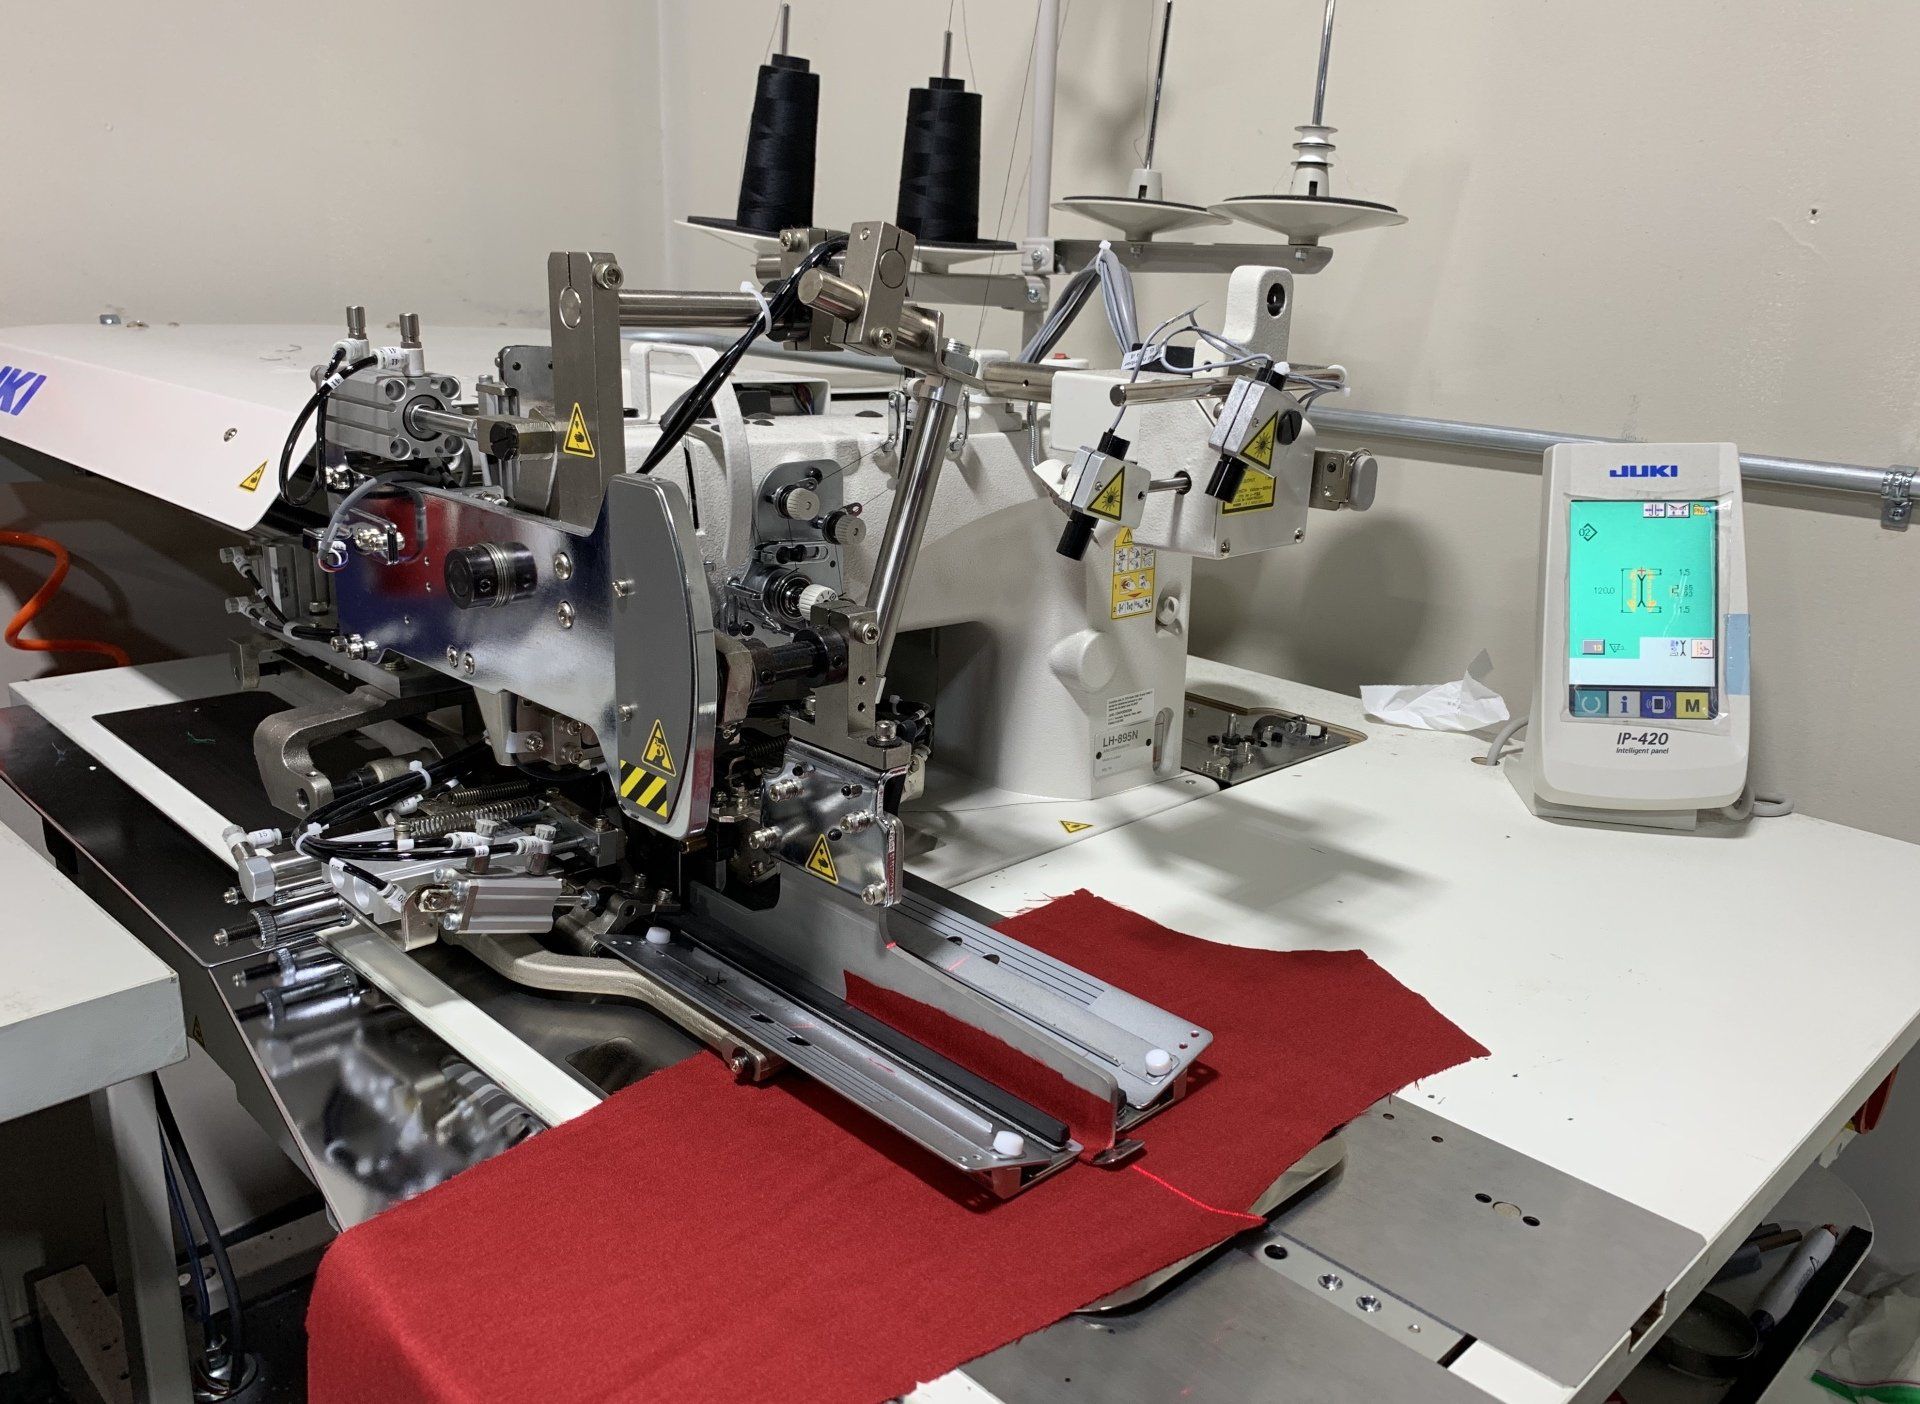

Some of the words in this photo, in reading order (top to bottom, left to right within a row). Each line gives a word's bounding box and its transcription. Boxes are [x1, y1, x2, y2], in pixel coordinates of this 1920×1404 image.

[1609, 465, 1678, 477] JUKI
[1579, 528, 1591, 537] 02
[1685, 699, 1700, 713] M
[1103, 730, 1138, 747] LH-895N
[1616, 732, 1669, 745] IP-420
[1615, 747, 1649, 756] Intelligent
[1650, 747, 1669, 755] panel
